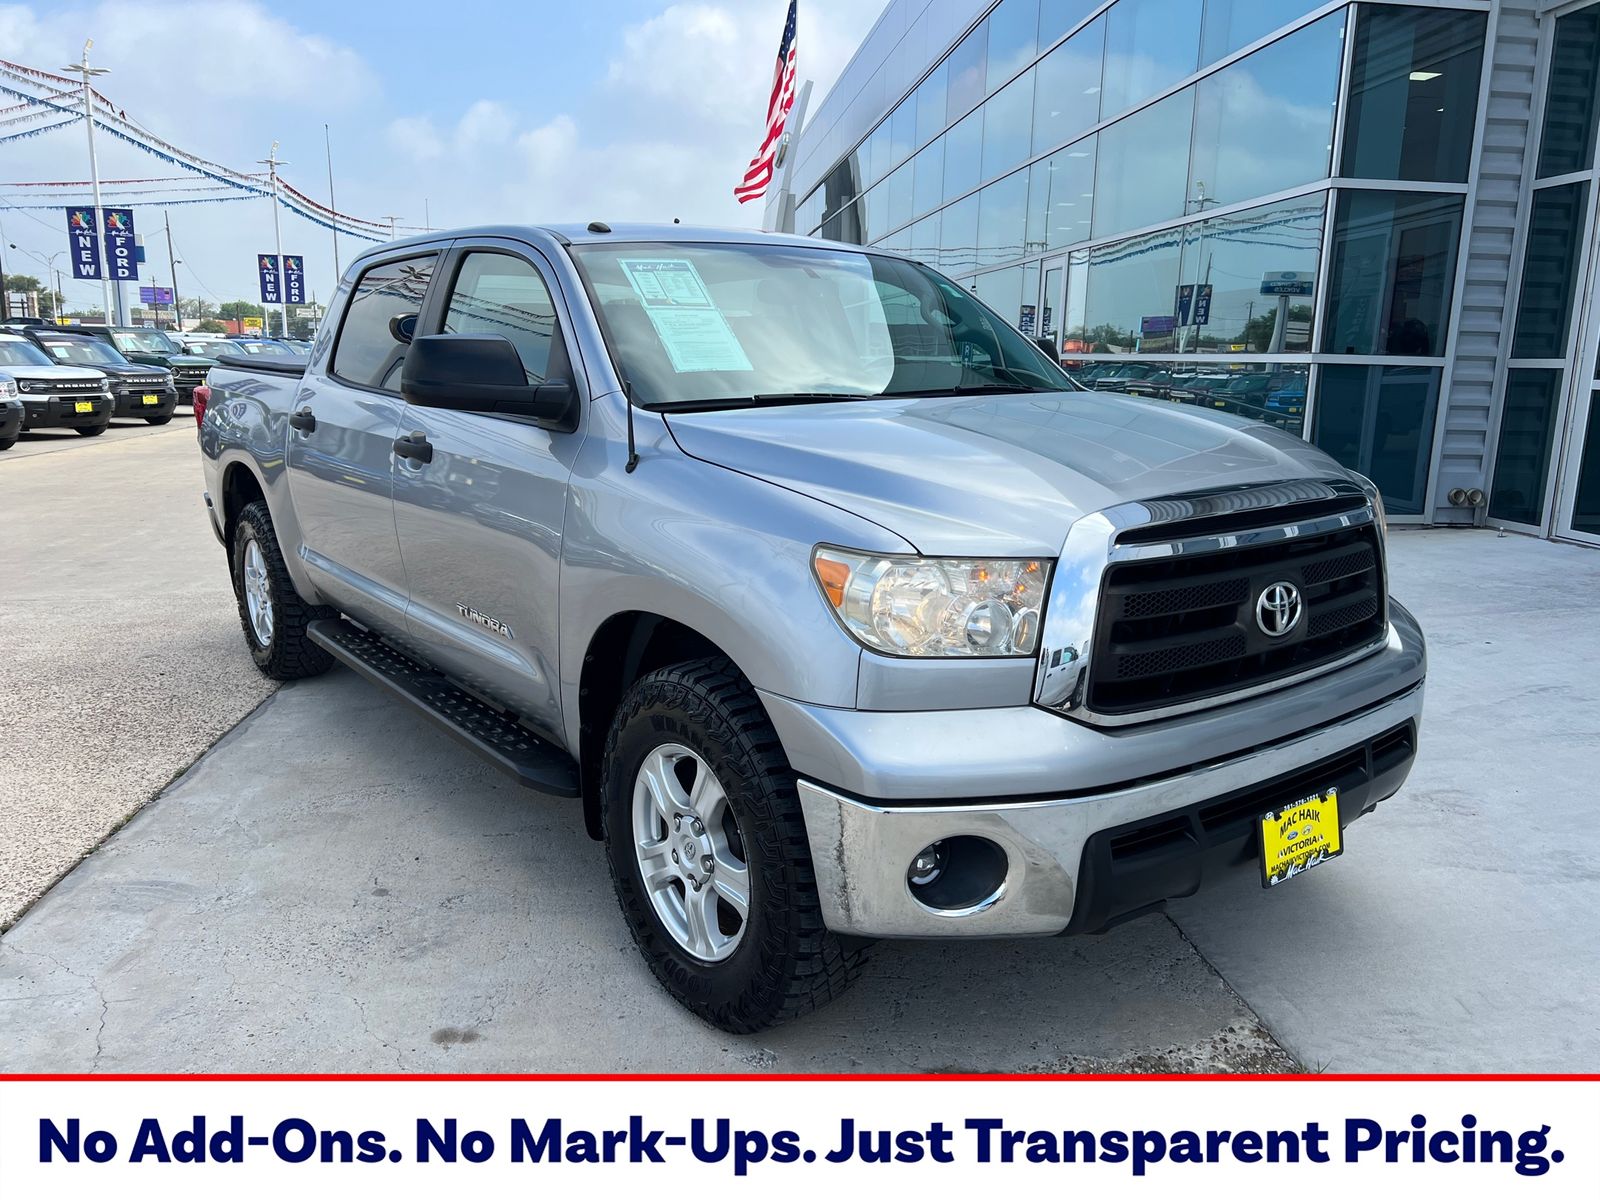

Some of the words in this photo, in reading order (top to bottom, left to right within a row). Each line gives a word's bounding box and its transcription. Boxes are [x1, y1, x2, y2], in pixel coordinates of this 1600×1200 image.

[79, 236, 95, 276] NEW
[115, 237, 129, 277] FORD
[265, 273, 277, 301] NEW
[290, 274, 300, 302] FORD
[456, 601, 514, 640] TUNDRA
[1280, 812, 1297, 839] MAC
[1298, 808, 1321, 823] HAIK
[1283, 835, 1319, 856] VICTORIA
[1286, 863, 1305, 880] Mac
